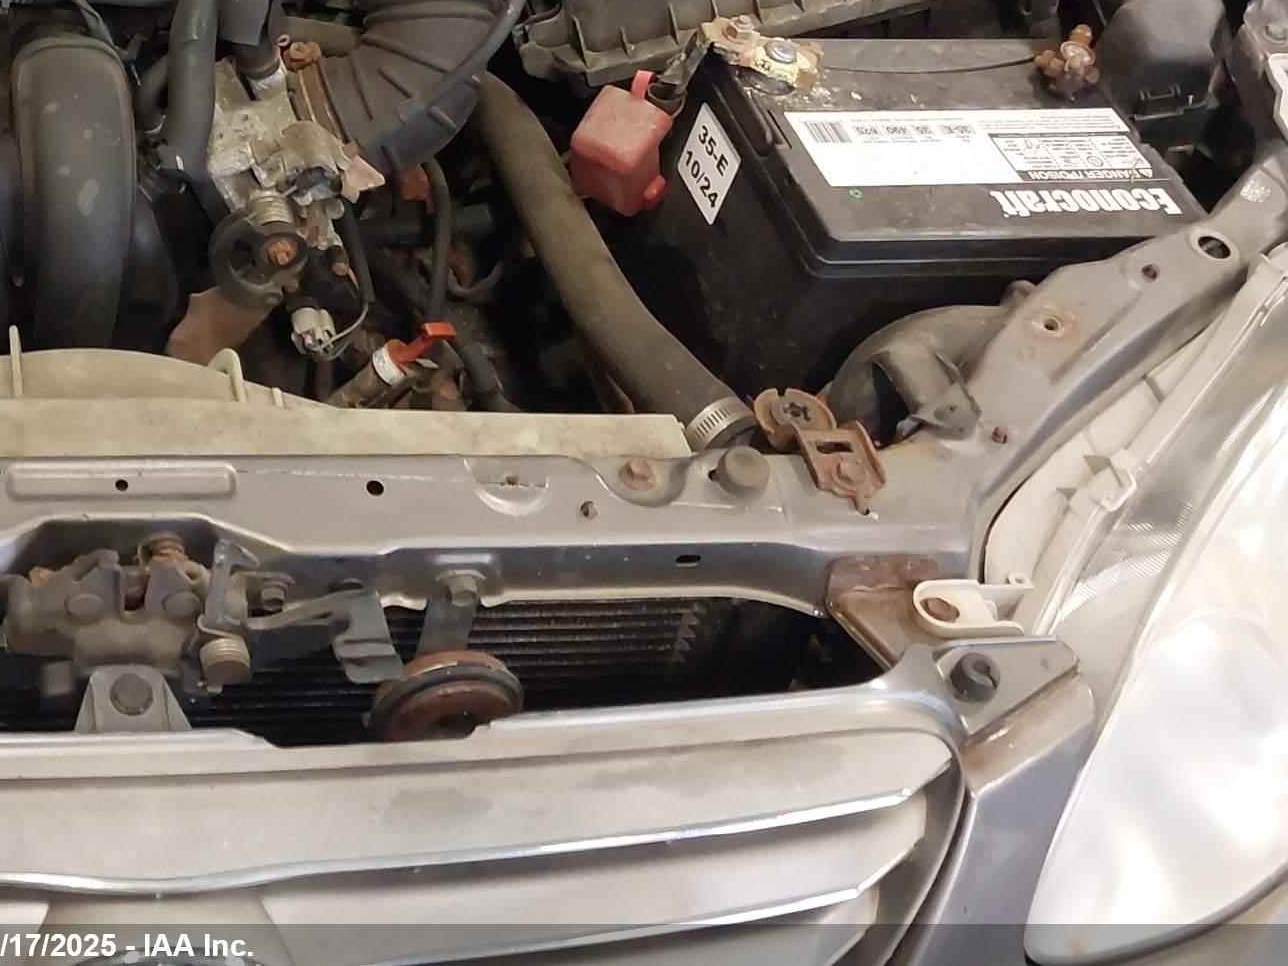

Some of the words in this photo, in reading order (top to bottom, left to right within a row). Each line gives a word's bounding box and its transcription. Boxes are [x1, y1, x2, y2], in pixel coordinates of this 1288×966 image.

[698, 125, 728, 176] 35-E
[685, 150, 718, 208] 10/24
[990, 188, 1182, 217] Econocraft
